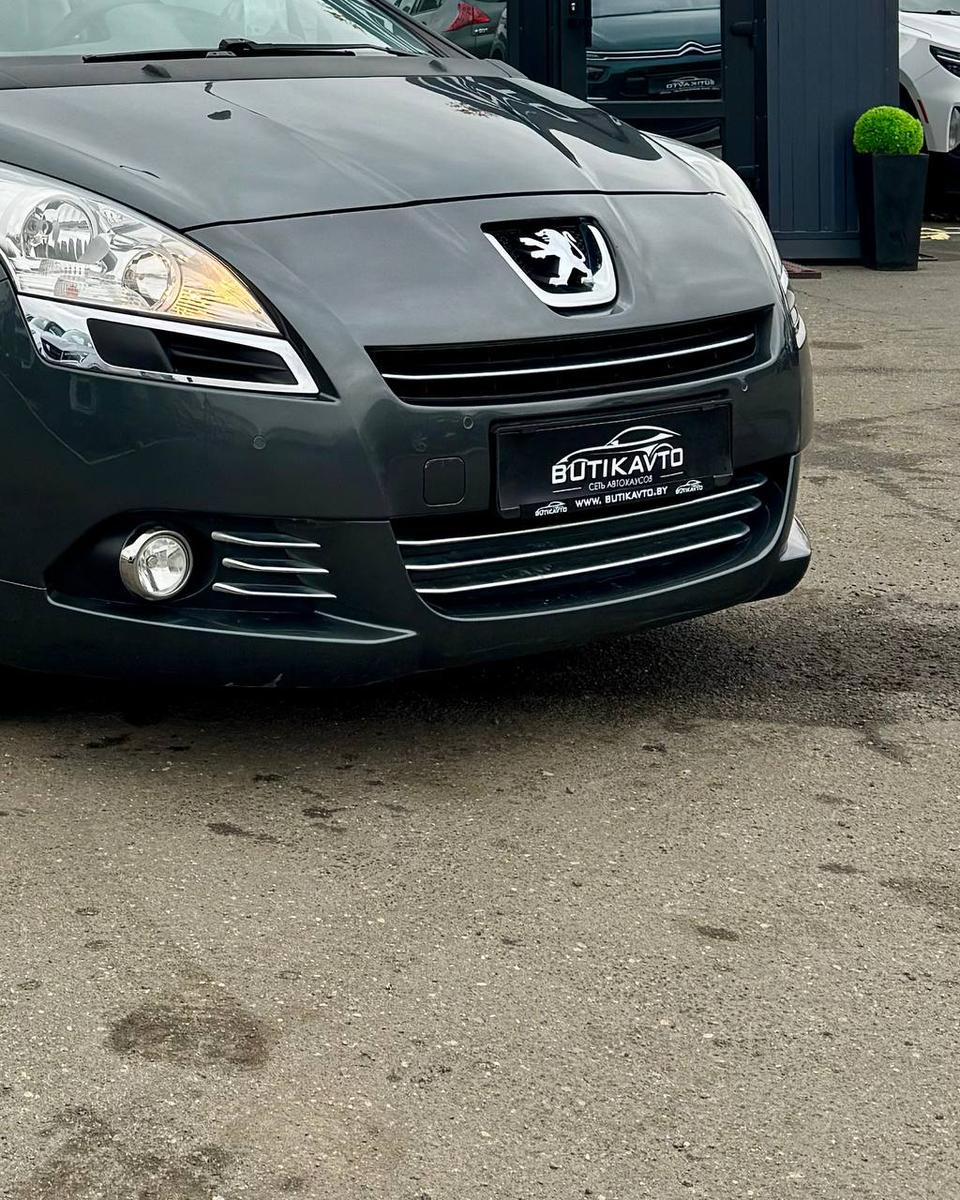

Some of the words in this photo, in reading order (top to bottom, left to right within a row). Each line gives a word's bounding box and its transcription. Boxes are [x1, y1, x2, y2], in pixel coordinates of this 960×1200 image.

[551, 448, 684, 485] BUTIKAVTO
[588, 481, 606, 491] СЕТЬ
[606, 474, 653, 488] АВТОХАУСОВ
[575, 497, 602, 508] WWW.
[604, 486, 668, 504] BUTIKAVTO.BY
